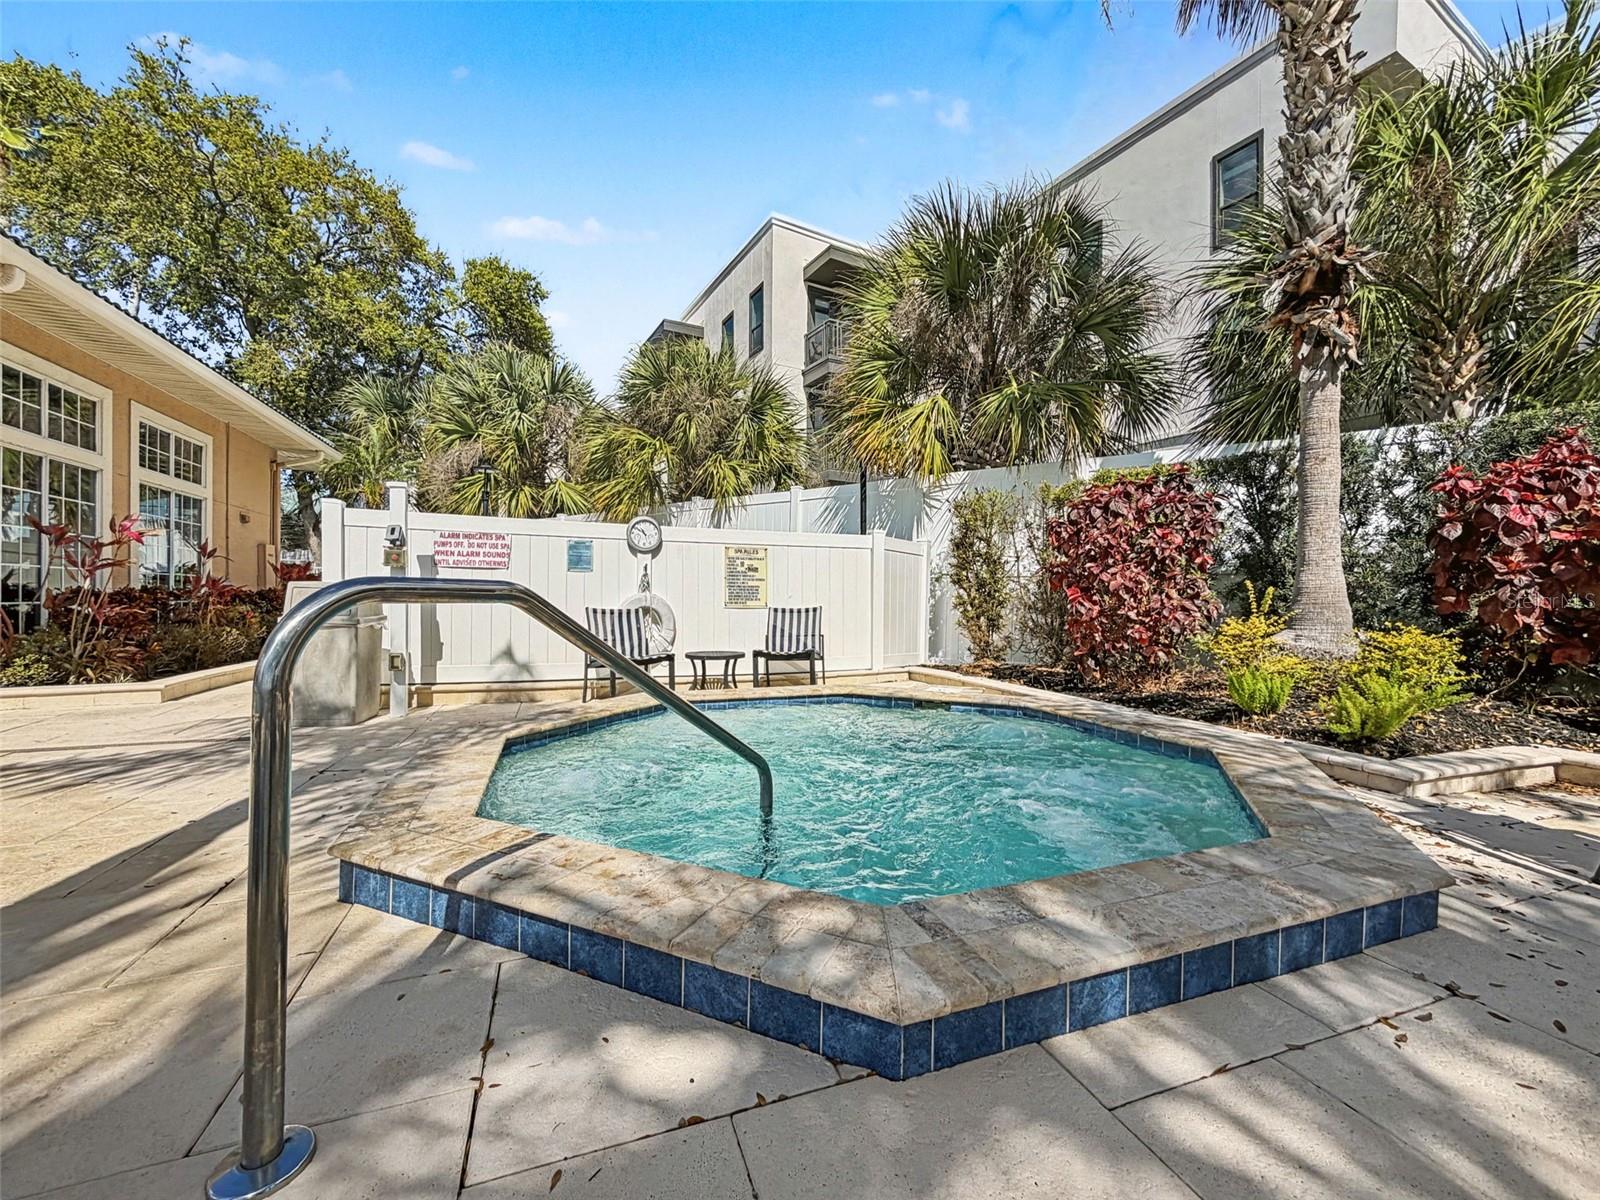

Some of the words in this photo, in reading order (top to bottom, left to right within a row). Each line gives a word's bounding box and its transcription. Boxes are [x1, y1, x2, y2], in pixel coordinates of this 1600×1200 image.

[462, 532, 493, 541] INDICATES
[433, 540, 452, 548] PUMPS
[434, 549, 455, 557] WHEN
[457, 550, 480, 558] ALARM
[482, 551, 511, 559] SOUNDS
[452, 559, 477, 567] ADVISED
